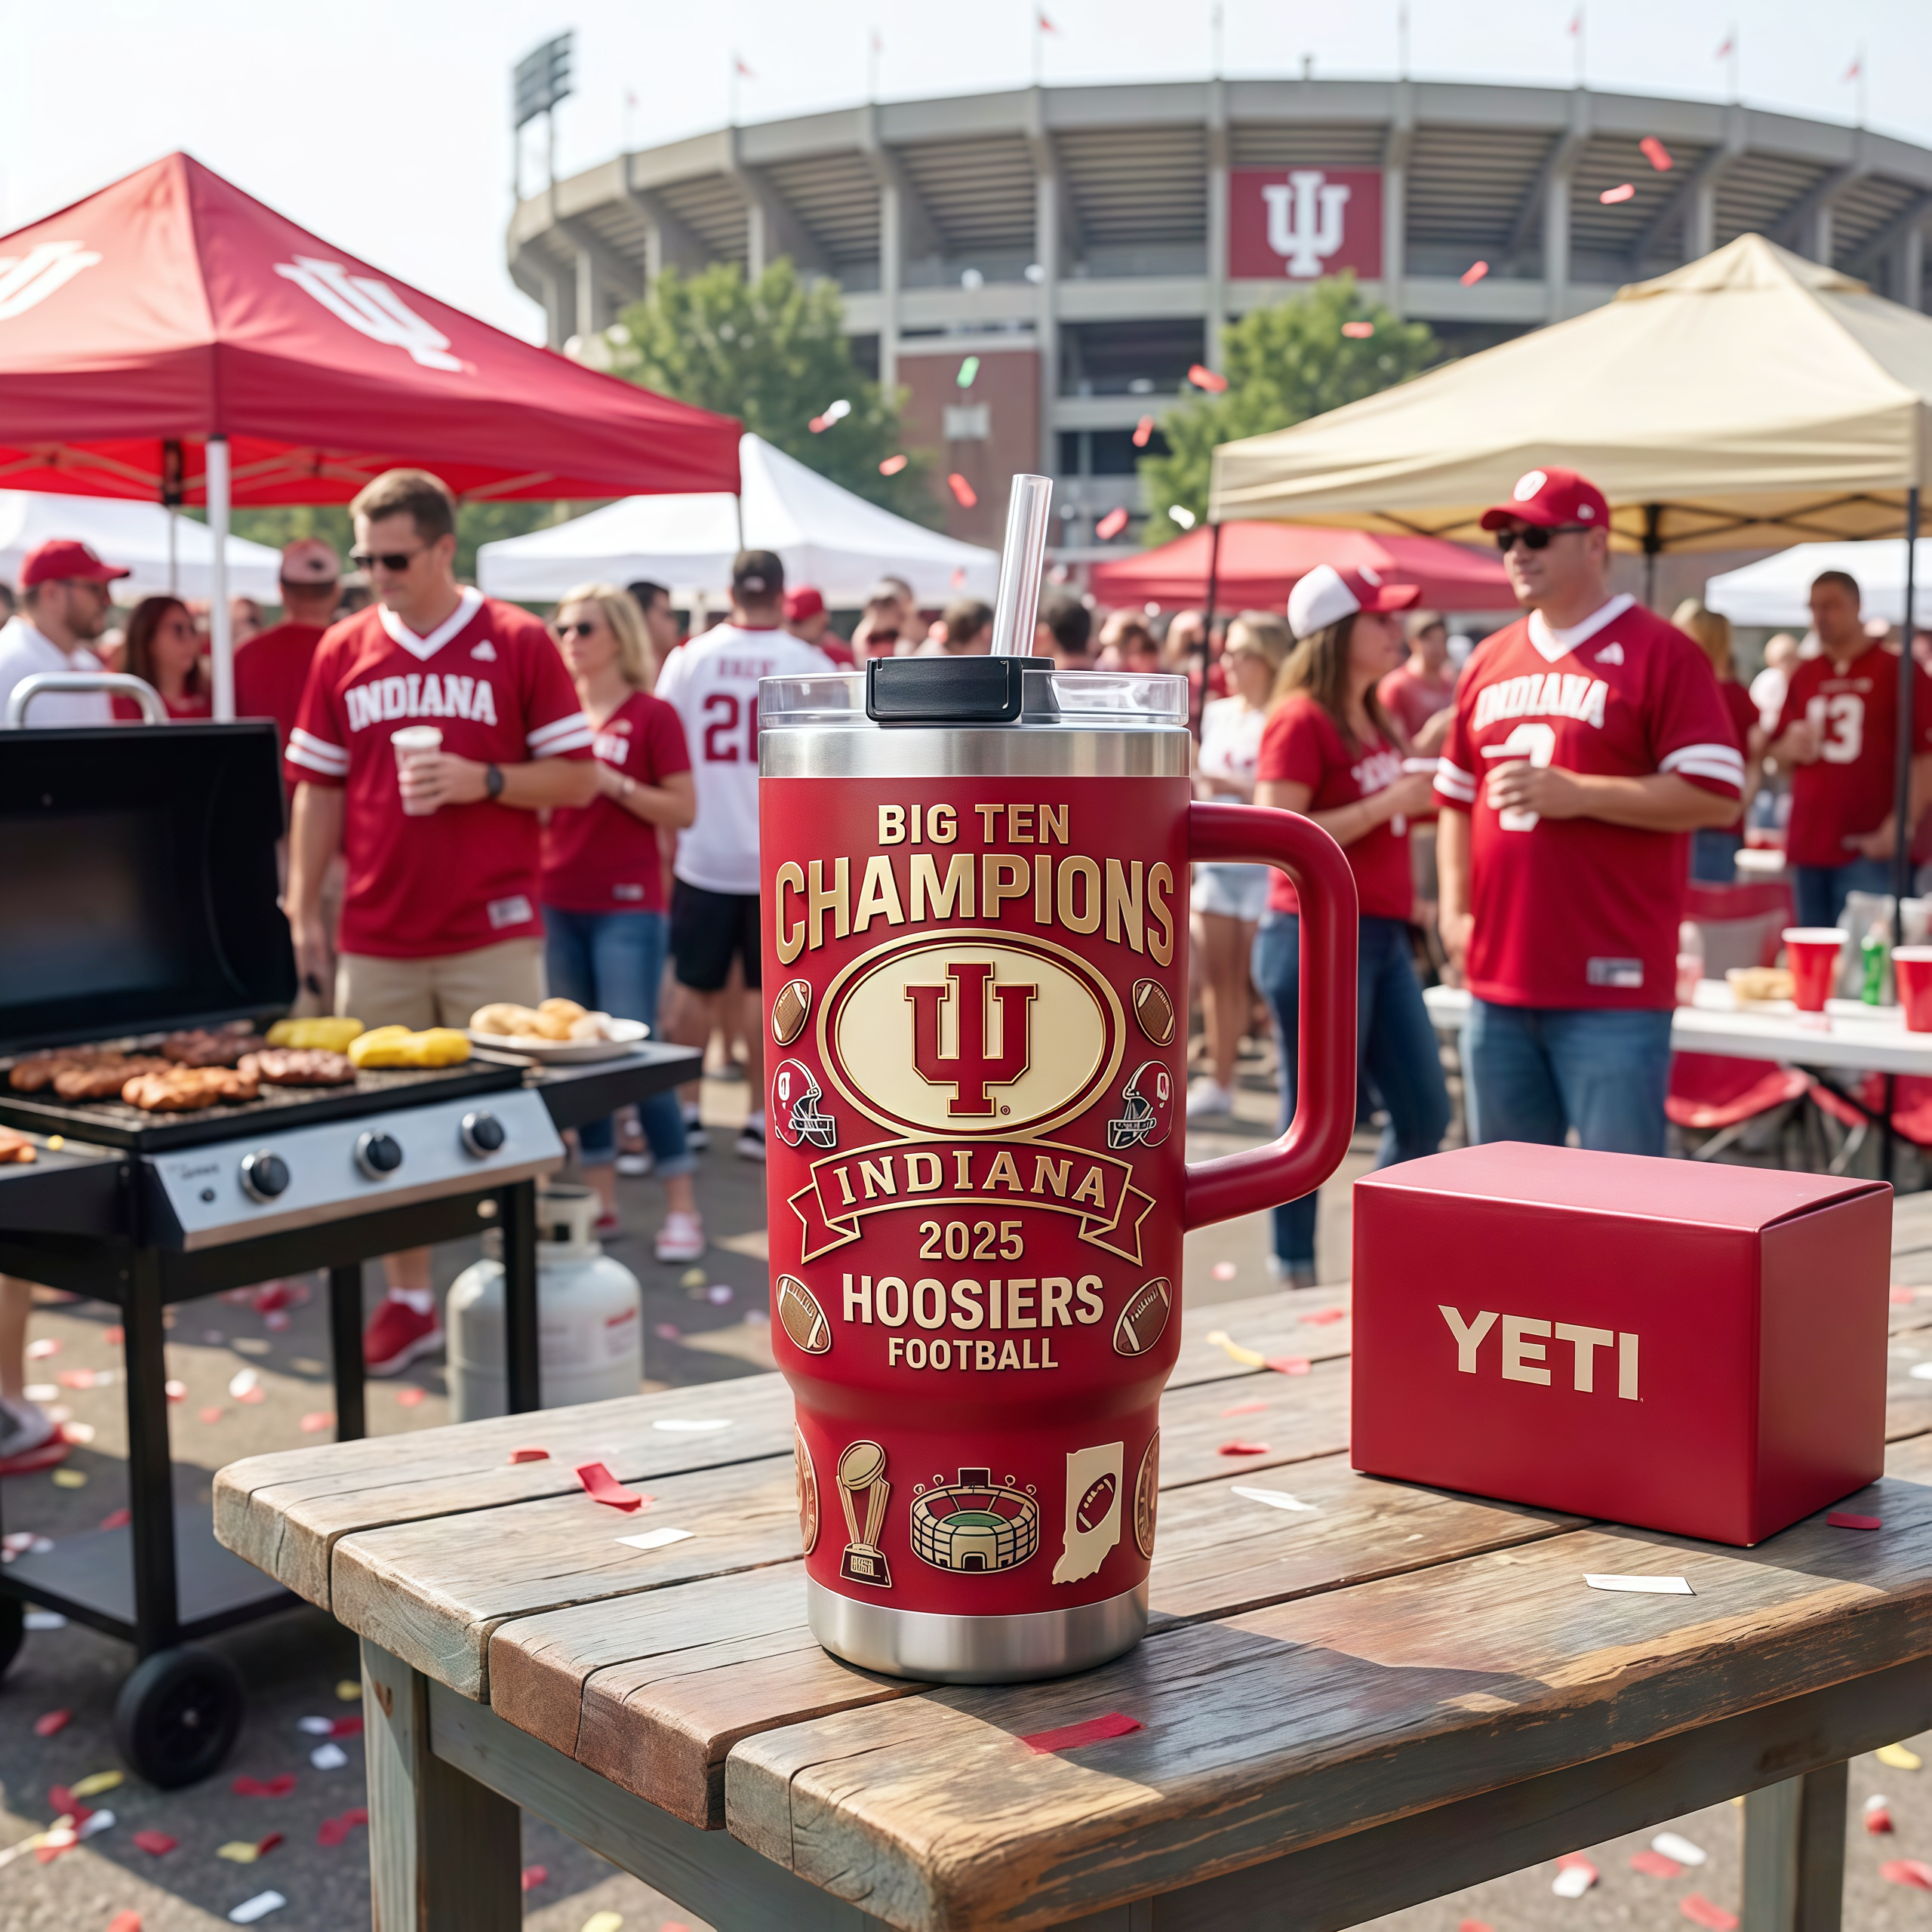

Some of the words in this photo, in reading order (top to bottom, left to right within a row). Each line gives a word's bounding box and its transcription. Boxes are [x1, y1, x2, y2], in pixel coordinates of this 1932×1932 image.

[344, 672, 498, 733] INDIANA
[1472, 672, 1610, 732] INDIANA
[877, 803, 958, 846] BIG
[974, 803, 1069, 845] TEN
[775, 852, 1174, 968] CHAMPIONS
[832, 1149, 1106, 1209] INDIANA
[918, 1220, 1025, 1261] 2025
[841, 1272, 1105, 1331] HOOSIERS
[888, 1337, 1060, 1371] FOOTBALL
[1437, 1303, 1639, 1401] YETI
